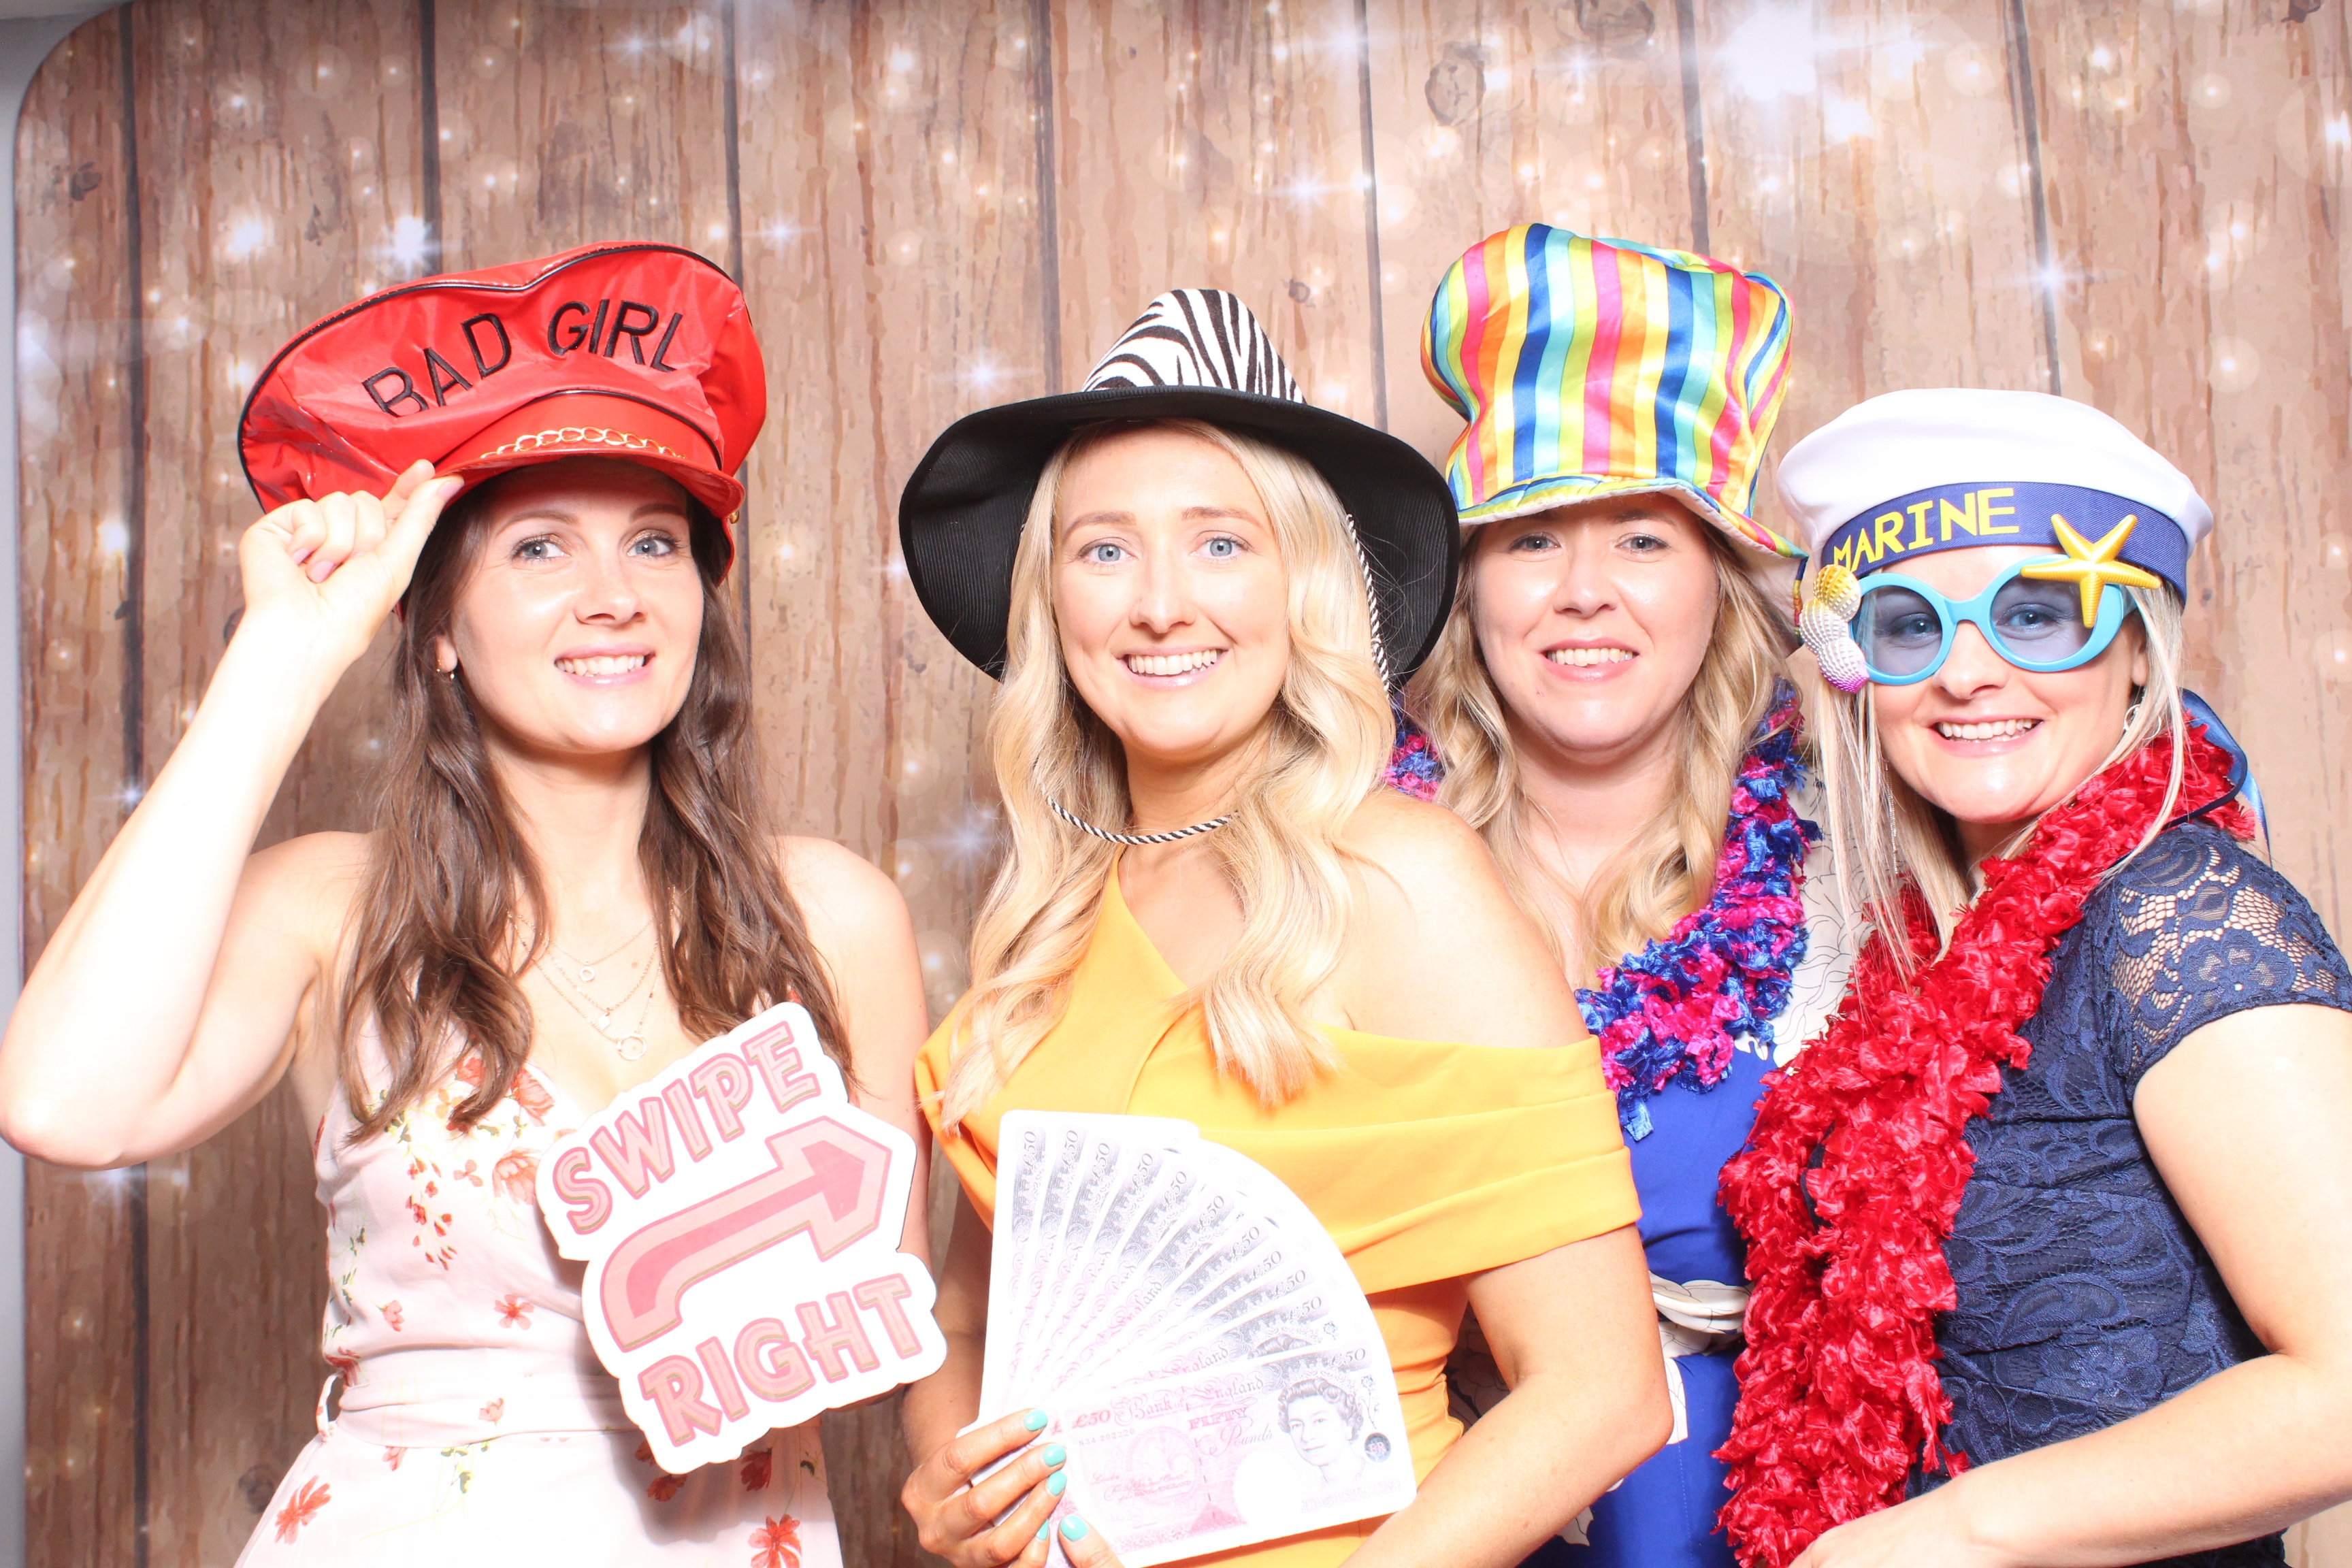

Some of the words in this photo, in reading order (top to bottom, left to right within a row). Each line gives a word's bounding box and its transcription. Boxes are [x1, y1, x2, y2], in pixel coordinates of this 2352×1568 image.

[362, 313, 510, 417] BAD
[548, 299, 683, 372] GIRL
[1833, 487, 2019, 572] MARINE
[553, 1020, 821, 1235] SWIPE
[1023, 1130, 1037, 1170] £50
[1061, 1130, 1079, 1169] £50
[1092, 1142, 1111, 1181] £50
[1132, 1152, 1154, 1190] £50
[1163, 1171, 1187, 1207] £50
[1198, 1195, 1224, 1228] £50
[1232, 1226, 1259, 1256] £50
[1252, 1251, 1281, 1279] £50
[1275, 1269, 1306, 1297] £50
[1289, 1296, 1322, 1320] £50
[638, 1273, 923, 1448] RIGHT
[1329, 1348, 1366, 1366] £50
[1111, 1392, 1172, 1426] Bank
[1174, 1396, 1185, 1409] of
[1192, 1372, 1264, 1403] England
[1072, 1409, 1111, 1429] £50
[1188, 1407, 1250, 1430] FIFTY
[1198, 1416, 1273, 1456] Pounds
[1079, 1437, 1096, 1447] N34
[1100, 1428, 1135, 1442] 202220
